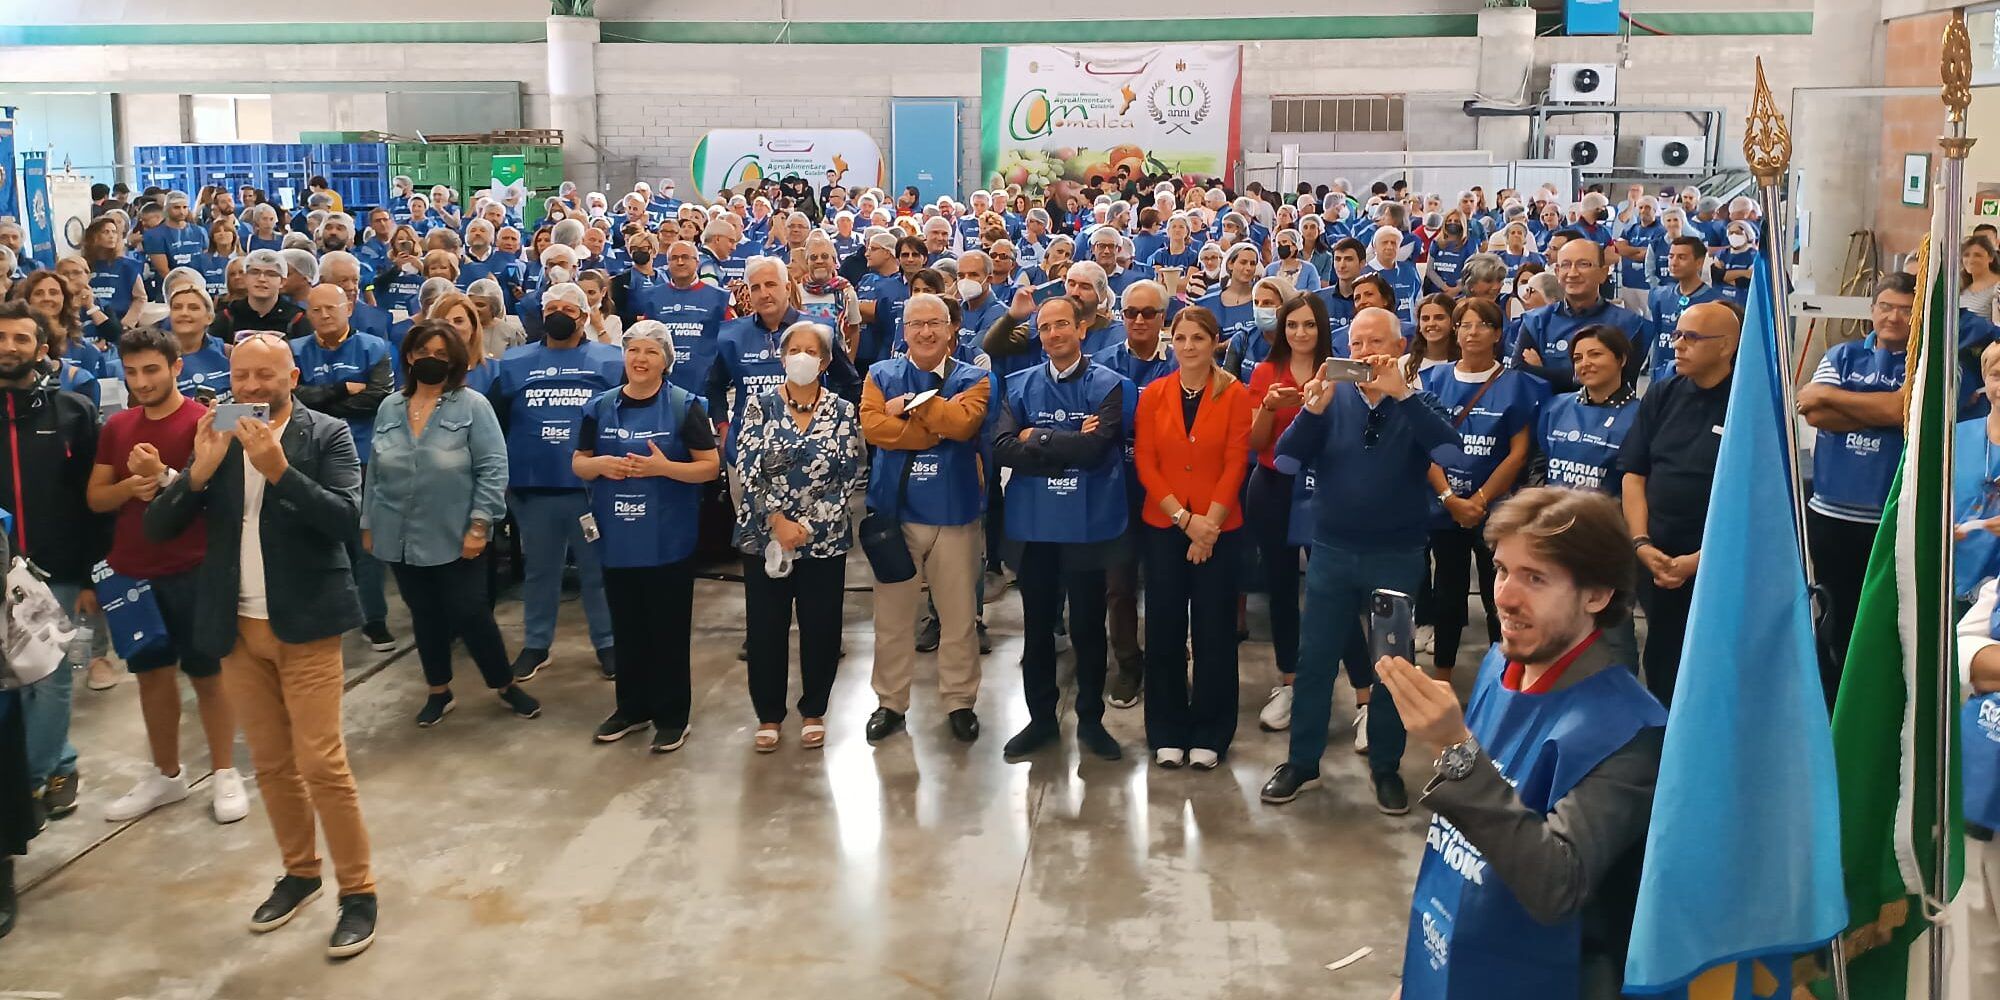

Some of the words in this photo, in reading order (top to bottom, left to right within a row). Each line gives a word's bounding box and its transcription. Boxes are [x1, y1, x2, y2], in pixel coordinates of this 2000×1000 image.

[1168, 85, 1194, 106] 10
[1167, 108, 1190, 117] anni
[767, 163, 827, 171] AgroAlimentare
[665, 322, 704, 331] OTARIAN
[742, 375, 785, 385] ROTARI
[525, 388, 592, 399] ROTARIAN
[527, 397, 546, 407] AT
[1462, 433, 1497, 446] RIAN
[1463, 445, 1492, 456] ORK
[1548, 458, 1608, 477] OTARIAN
